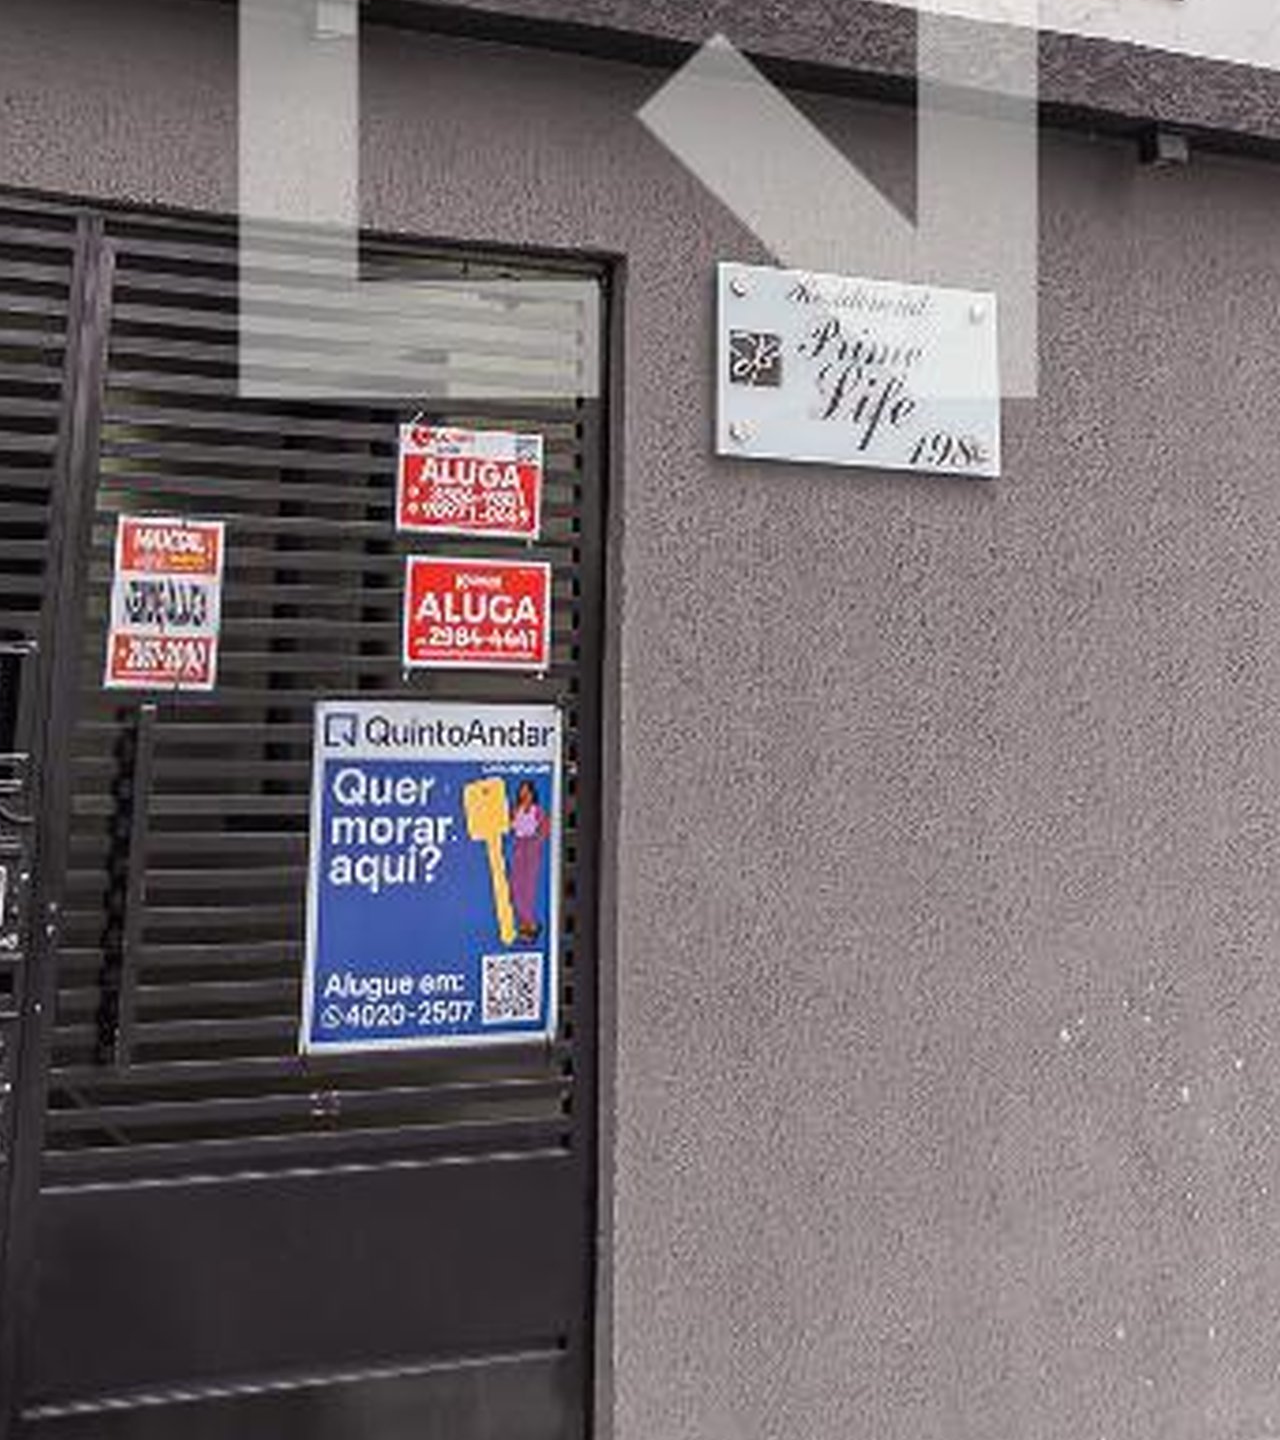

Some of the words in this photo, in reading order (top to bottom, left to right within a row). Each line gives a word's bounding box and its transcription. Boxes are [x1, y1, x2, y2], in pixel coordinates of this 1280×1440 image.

[797, 318, 922, 368] Prime
[817, 360, 916, 452] Life
[421, 457, 519, 489] ALUGA
[416, 591, 538, 625] ALUGA
[365, 715, 555, 748] QuintoAndar
[332, 767, 435, 806] Quer
[328, 845, 442, 894] aqui?
[323, 972, 413, 1002] Alugue
[419, 973, 465, 995] em:
